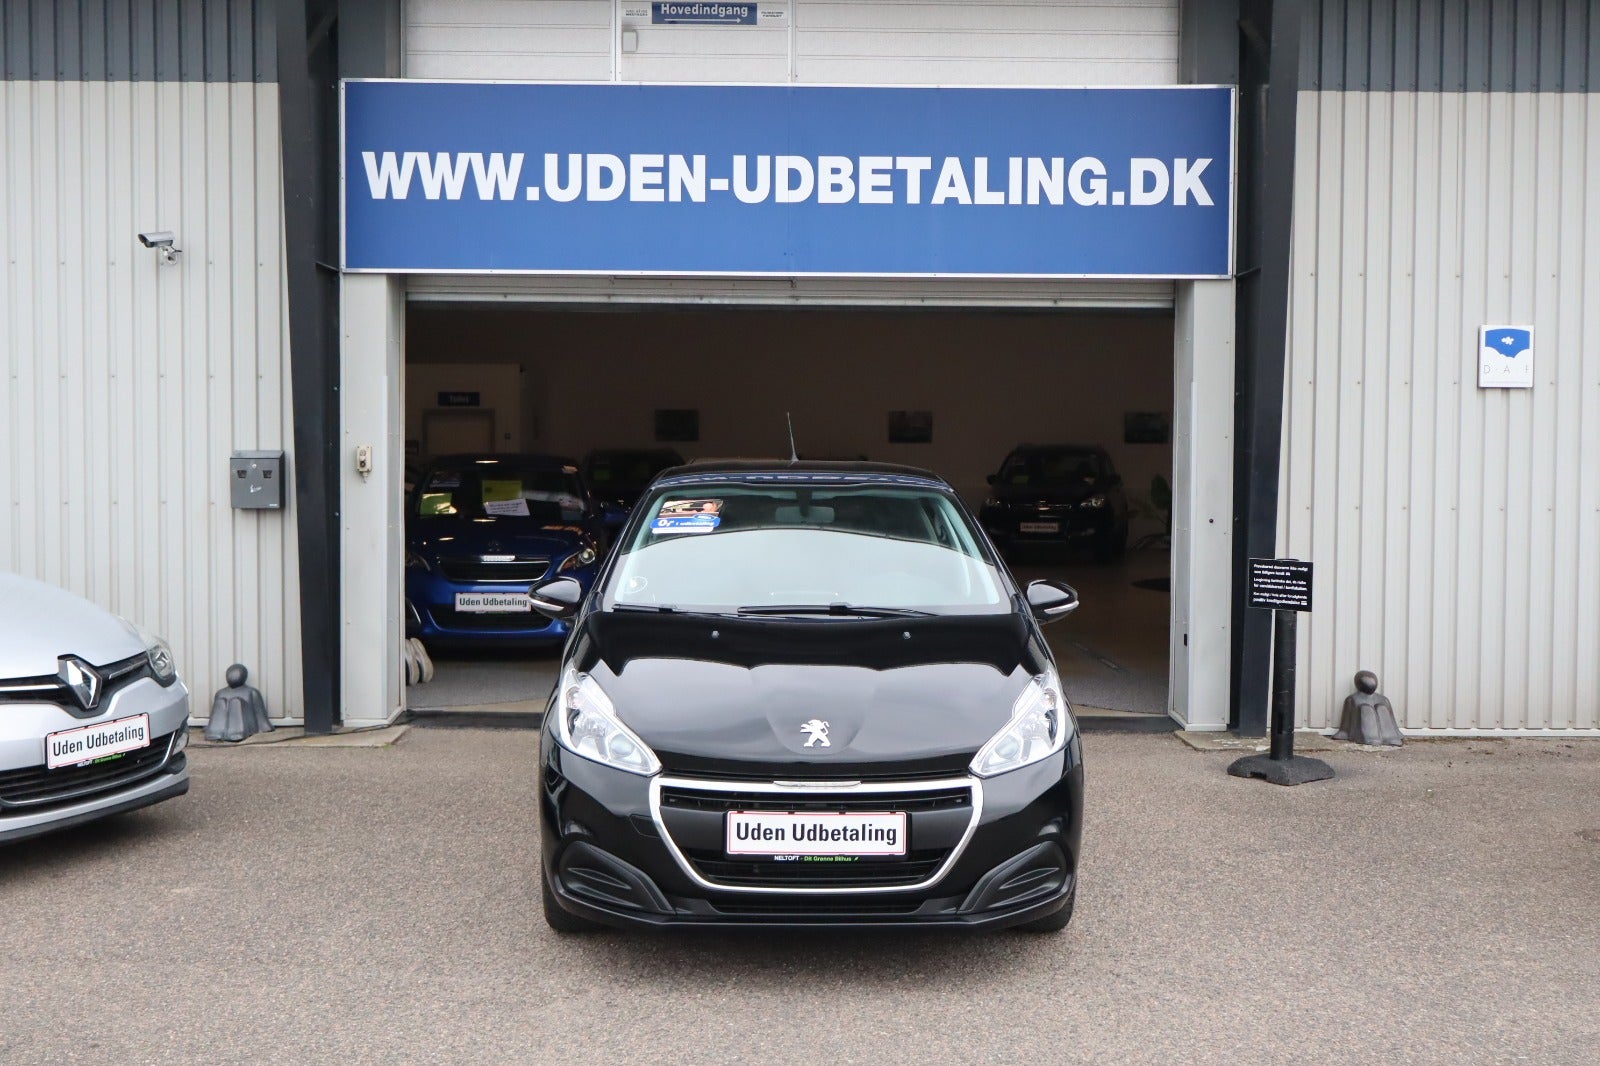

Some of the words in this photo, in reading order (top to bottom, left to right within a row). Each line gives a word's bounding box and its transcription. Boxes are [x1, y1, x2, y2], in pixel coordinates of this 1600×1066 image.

[661, 4, 748, 17] Hovedindgang
[362, 152, 1215, 207] WWW.UDEN-UDBETALING.DK
[459, 598, 480, 606] Uden
[483, 598, 527, 608] Udbetaling
[53, 740, 82, 756] Uden
[86, 726, 144, 749] Udbetaling
[736, 822, 785, 841] Uden
[792, 823, 897, 846] Udbetaling
